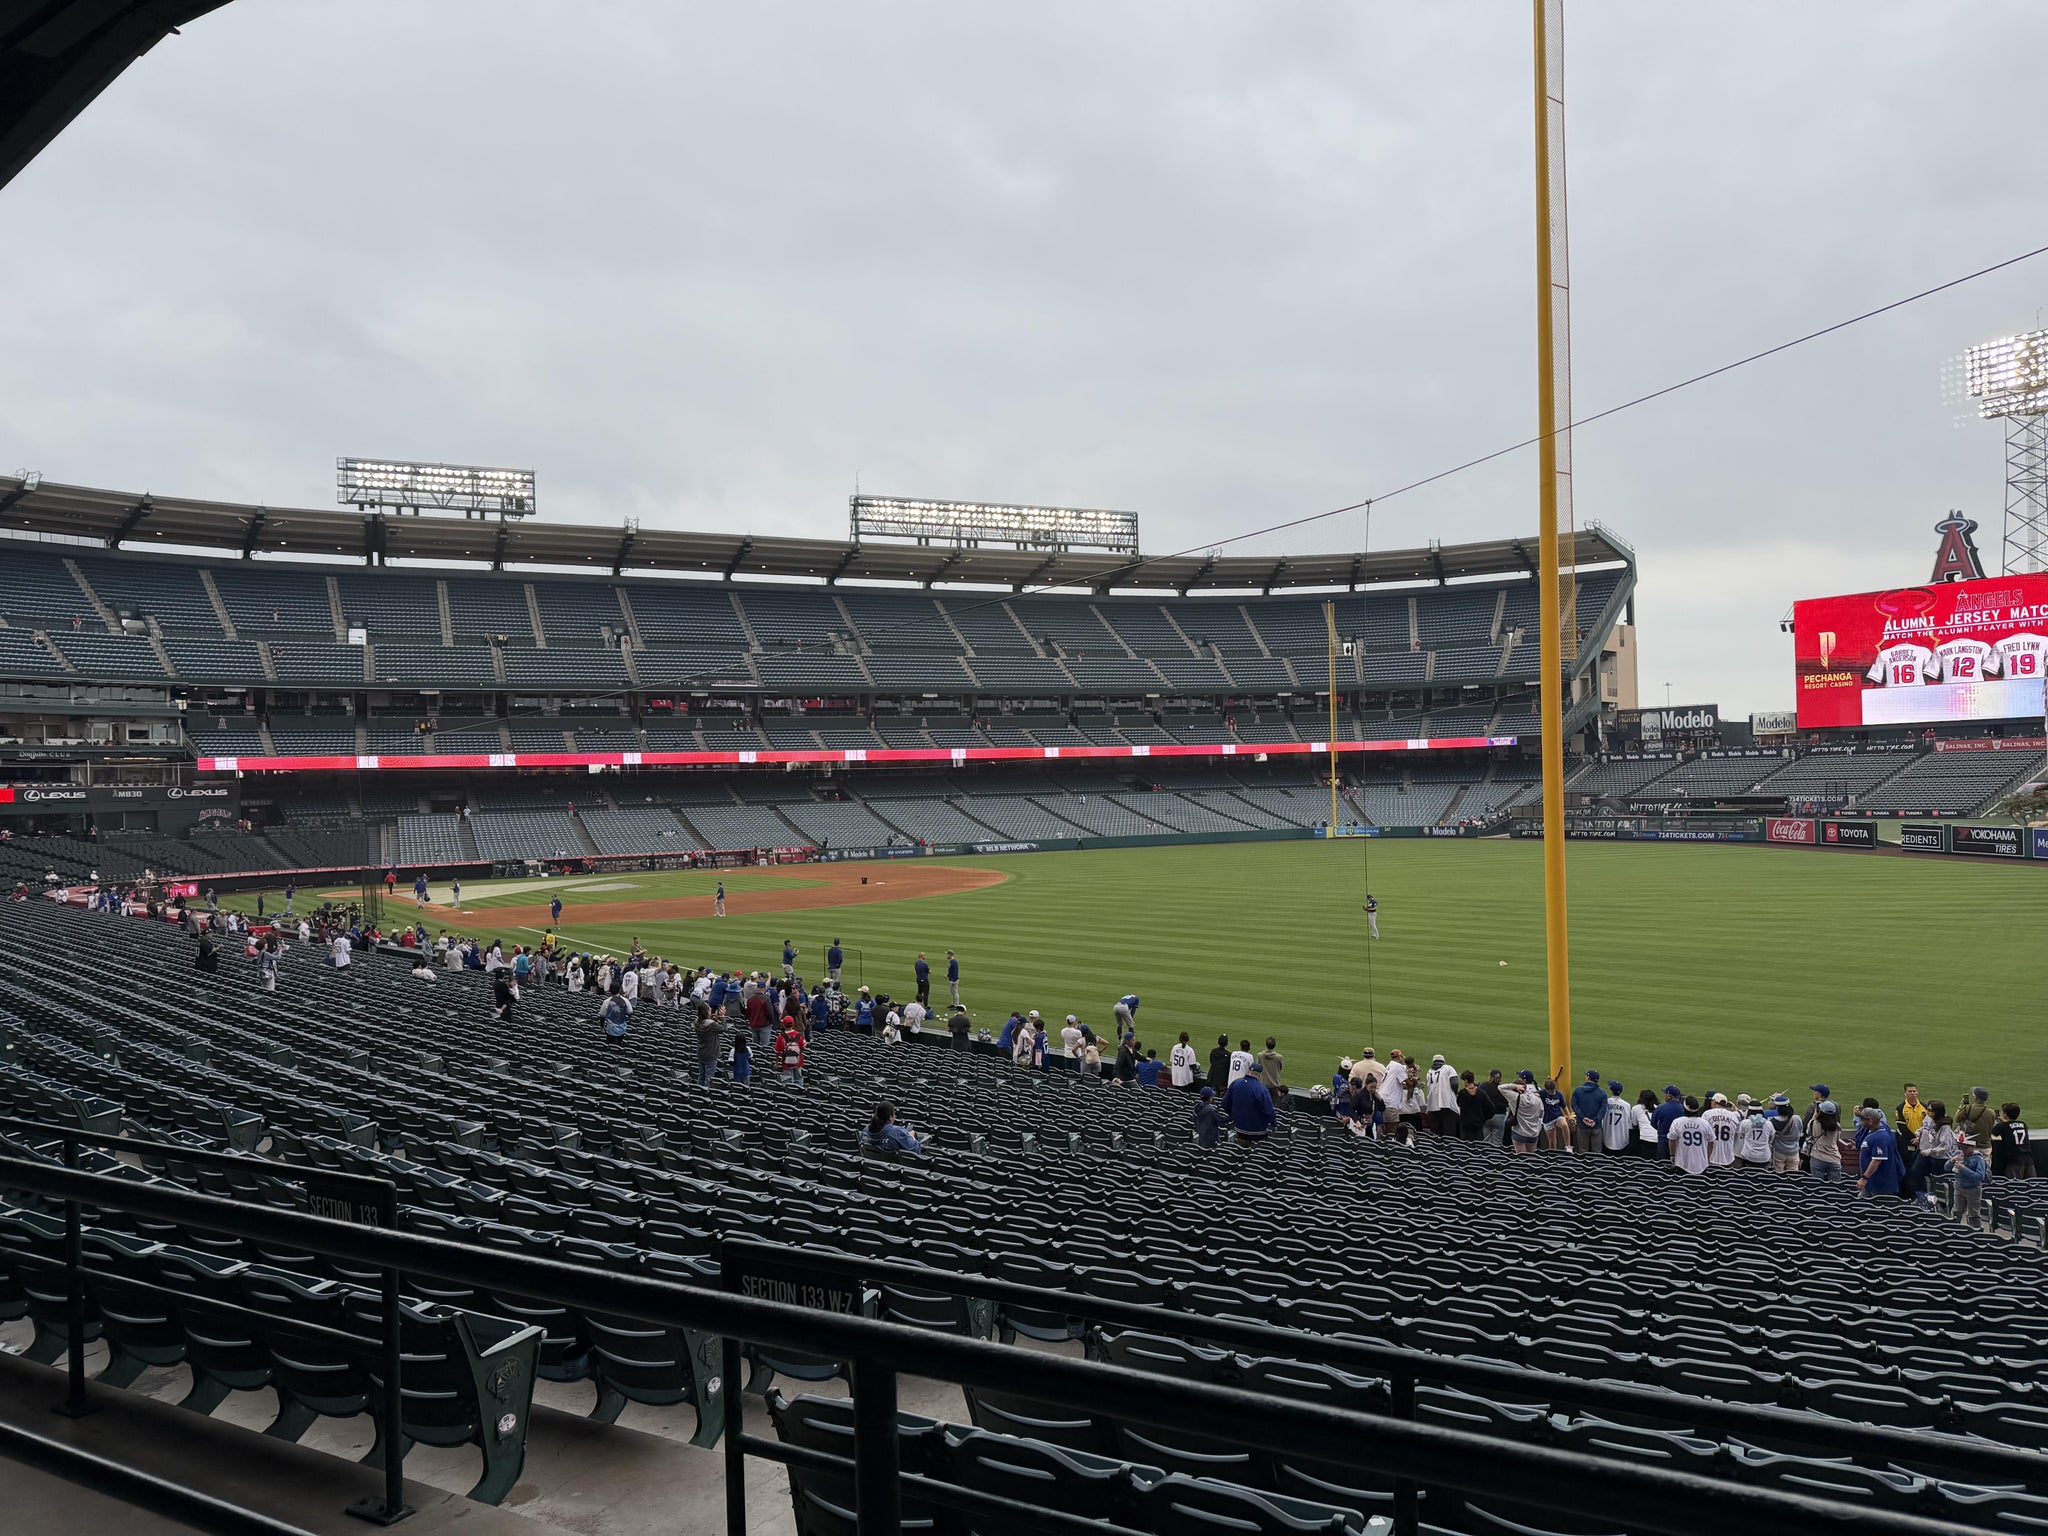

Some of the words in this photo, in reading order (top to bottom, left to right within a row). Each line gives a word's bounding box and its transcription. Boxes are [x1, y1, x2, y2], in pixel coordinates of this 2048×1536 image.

[1928, 509, 1985, 585] A
[1954, 588, 2024, 612] ANGELS
[1884, 615, 1936, 632] ALUMNI
[1945, 609, 2001, 626] JERSEY
[2010, 604, 2048, 620] MATC
[1883, 632, 1913, 641] MATCH
[1917, 630, 1934, 638] THE
[1938, 626, 1974, 636] ALUMNI
[1977, 622, 2015, 632] PLAYER
[2019, 619, 2044, 629] WITH
[1938, 648, 1954, 659] MARK
[2003, 642, 2021, 654] FRED
[2022, 641, 2041, 652] LYNN
[1952, 656, 1975, 678] 12
[2010, 654, 2036, 676] 19
[1804, 672, 1853, 684] PECHANGA
[1892, 664, 1915, 685] 16
[1804, 682, 1827, 690] RESORT
[1661, 710, 1714, 730] Modelo
[1757, 717, 1792, 730] Modelo
[41, 791, 87, 799] LEXUS
[183, 789, 229, 797] LEXUS
[1432, 826, 1456, 836] Modelo
[1658, 831, 1715, 840] 714TICKETS.COM
[1839, 828, 1869, 839] TOYOTA
[1970, 828, 2017, 841] YOKOHAMA
[999, 844, 1029, 852] NETWORK
[1994, 844, 2017, 854] TIRES
[1173, 1054, 1185, 1067] 50
[1232, 1060, 1241, 1071] 18
[1429, 1070, 1441, 1084] 17
[1609, 1112, 1622, 1126] 17
[1682, 1130, 1703, 1147] 99
[1713, 1124, 1731, 1142] 16
[1752, 1129, 1763, 1141] 17
[2013, 1128, 2026, 1145] 17
[309, 1195, 352, 1223] SECTION
[359, 1204, 378, 1227] 133
[742, 1275, 797, 1305] SECTION
[801, 1285, 825, 1310] 133
[828, 1289, 854, 1315] W-Z
